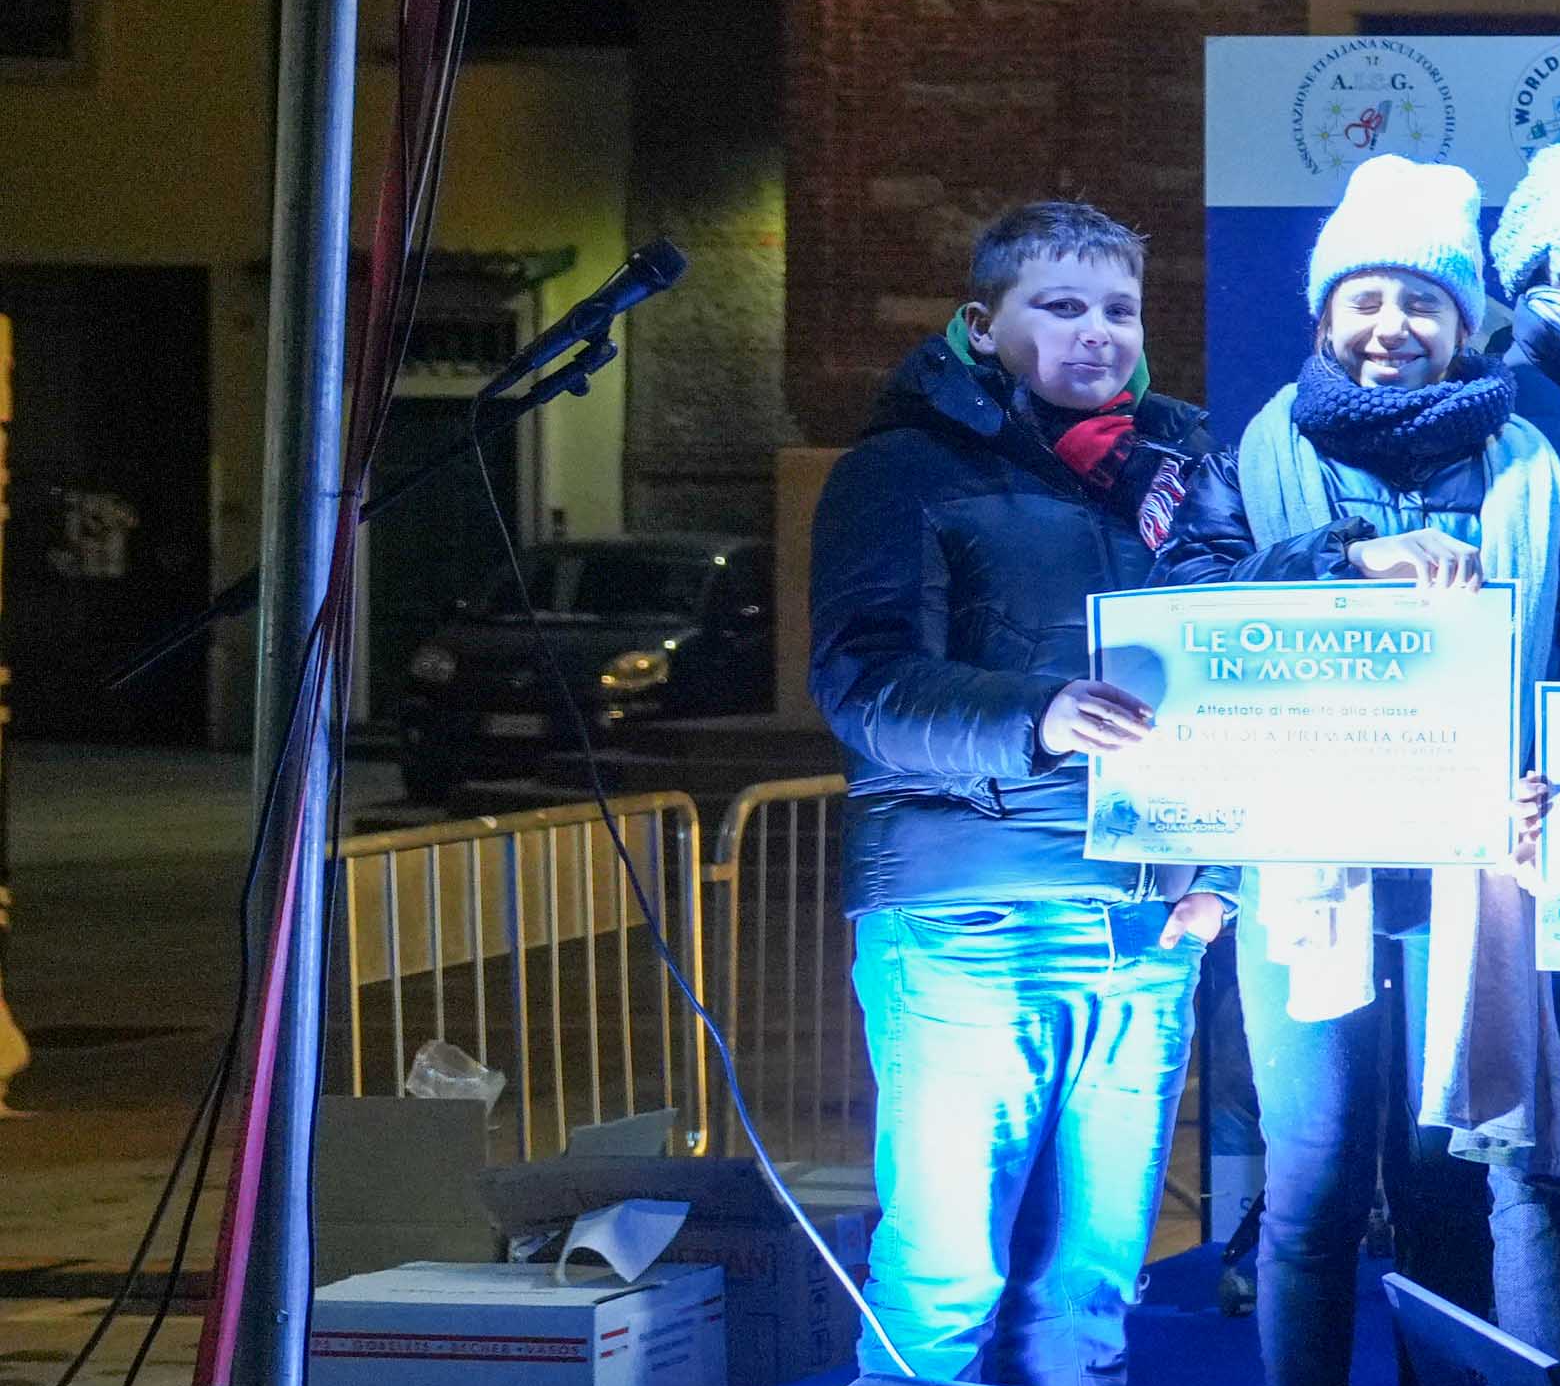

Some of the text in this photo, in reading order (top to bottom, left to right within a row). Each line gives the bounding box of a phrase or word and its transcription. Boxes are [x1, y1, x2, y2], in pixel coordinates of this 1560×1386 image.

[1514, 56, 1560, 126] WORLD
[1183, 622, 1433, 654] LE OLIMPIADI
[1209, 657, 1405, 681] IN MOSTRA
[1196, 704, 1265, 717] Attestato
[1268, 704, 1283, 716] di
[1288, 704, 1338, 717] meito
[1401, 726, 1459, 743] GALLI
